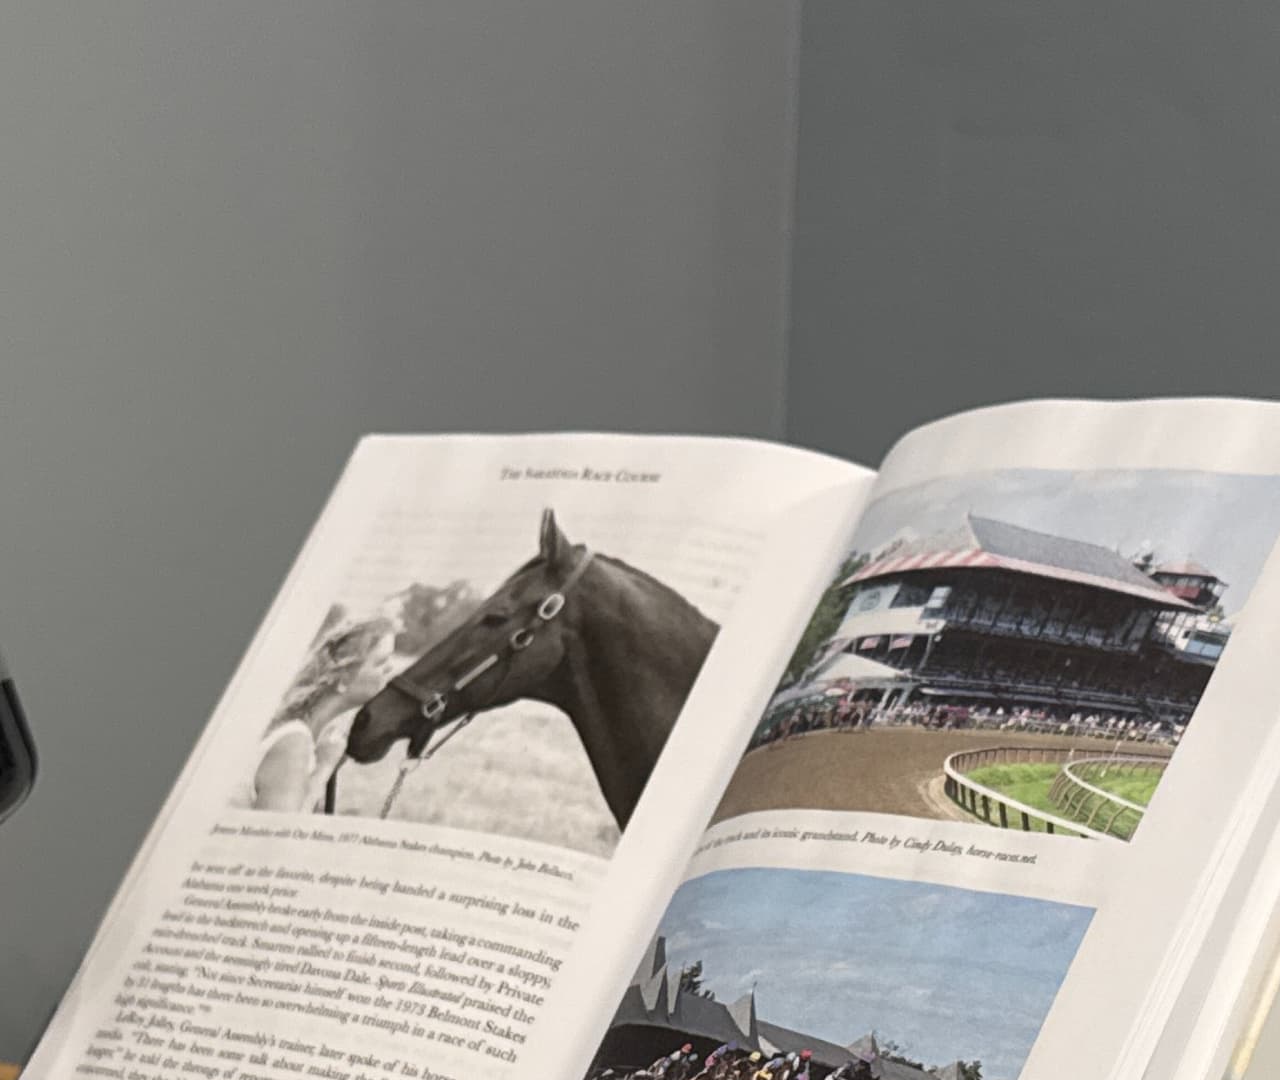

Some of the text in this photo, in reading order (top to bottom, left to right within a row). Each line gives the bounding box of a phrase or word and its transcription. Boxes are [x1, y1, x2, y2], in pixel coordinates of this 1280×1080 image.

[860, 831, 888, 845] Photo
[888, 835, 902, 850] by
[903, 836, 933, 853] Cindy
[319, 872, 356, 888] despite
[359, 877, 390, 894] being
[392, 881, 436, 898] handed
[438, 891, 445, 900] a
[448, 894, 509, 915] surprising
[512, 903, 535, 918] loss
[539, 912, 553, 924] in
[557, 915, 580, 931] the
[335, 933, 350, 945] up
[352, 935, 359, 944] a
[439, 947, 467, 964] lead
[467, 957, 495, 970] over
[496, 964, 505, 973] a
[507, 965, 552, 989] sloppy,
[350, 914, 368, 925] the
[430, 928, 468, 947] taking
[468, 937, 476, 946] a
[477, 939, 563, 972] commanding
[299, 962, 341, 980] Davona
[461, 997, 512, 1017] praised
[512, 1008, 535, 1024] the
[424, 965, 478, 987] followed
[477, 976, 495, 994] by
[496, 981, 544, 1006] Private
[274, 1000, 350, 1024] overwhelming
[351, 1014, 360, 1022] a
[362, 1015, 410, 1034] triumph
[411, 1026, 425, 1037] in
[426, 1030, 435, 1039] a
[437, 1032, 465, 1047] race
[467, 1040, 486, 1051] of
[485, 1046, 517, 1063] such
[373, 995, 392, 1008] the
[395, 999, 426, 1016] 1973
[427, 1006, 481, 1030] Belmont
[482, 1020, 526, 1044] Stakes
[272, 1056, 304, 1072] about
[318, 1044, 346, 1060] later
[347, 1054, 380, 1068] spoke
[382, 1059, 400, 1072] of
[400, 1062, 418, 1077] his
